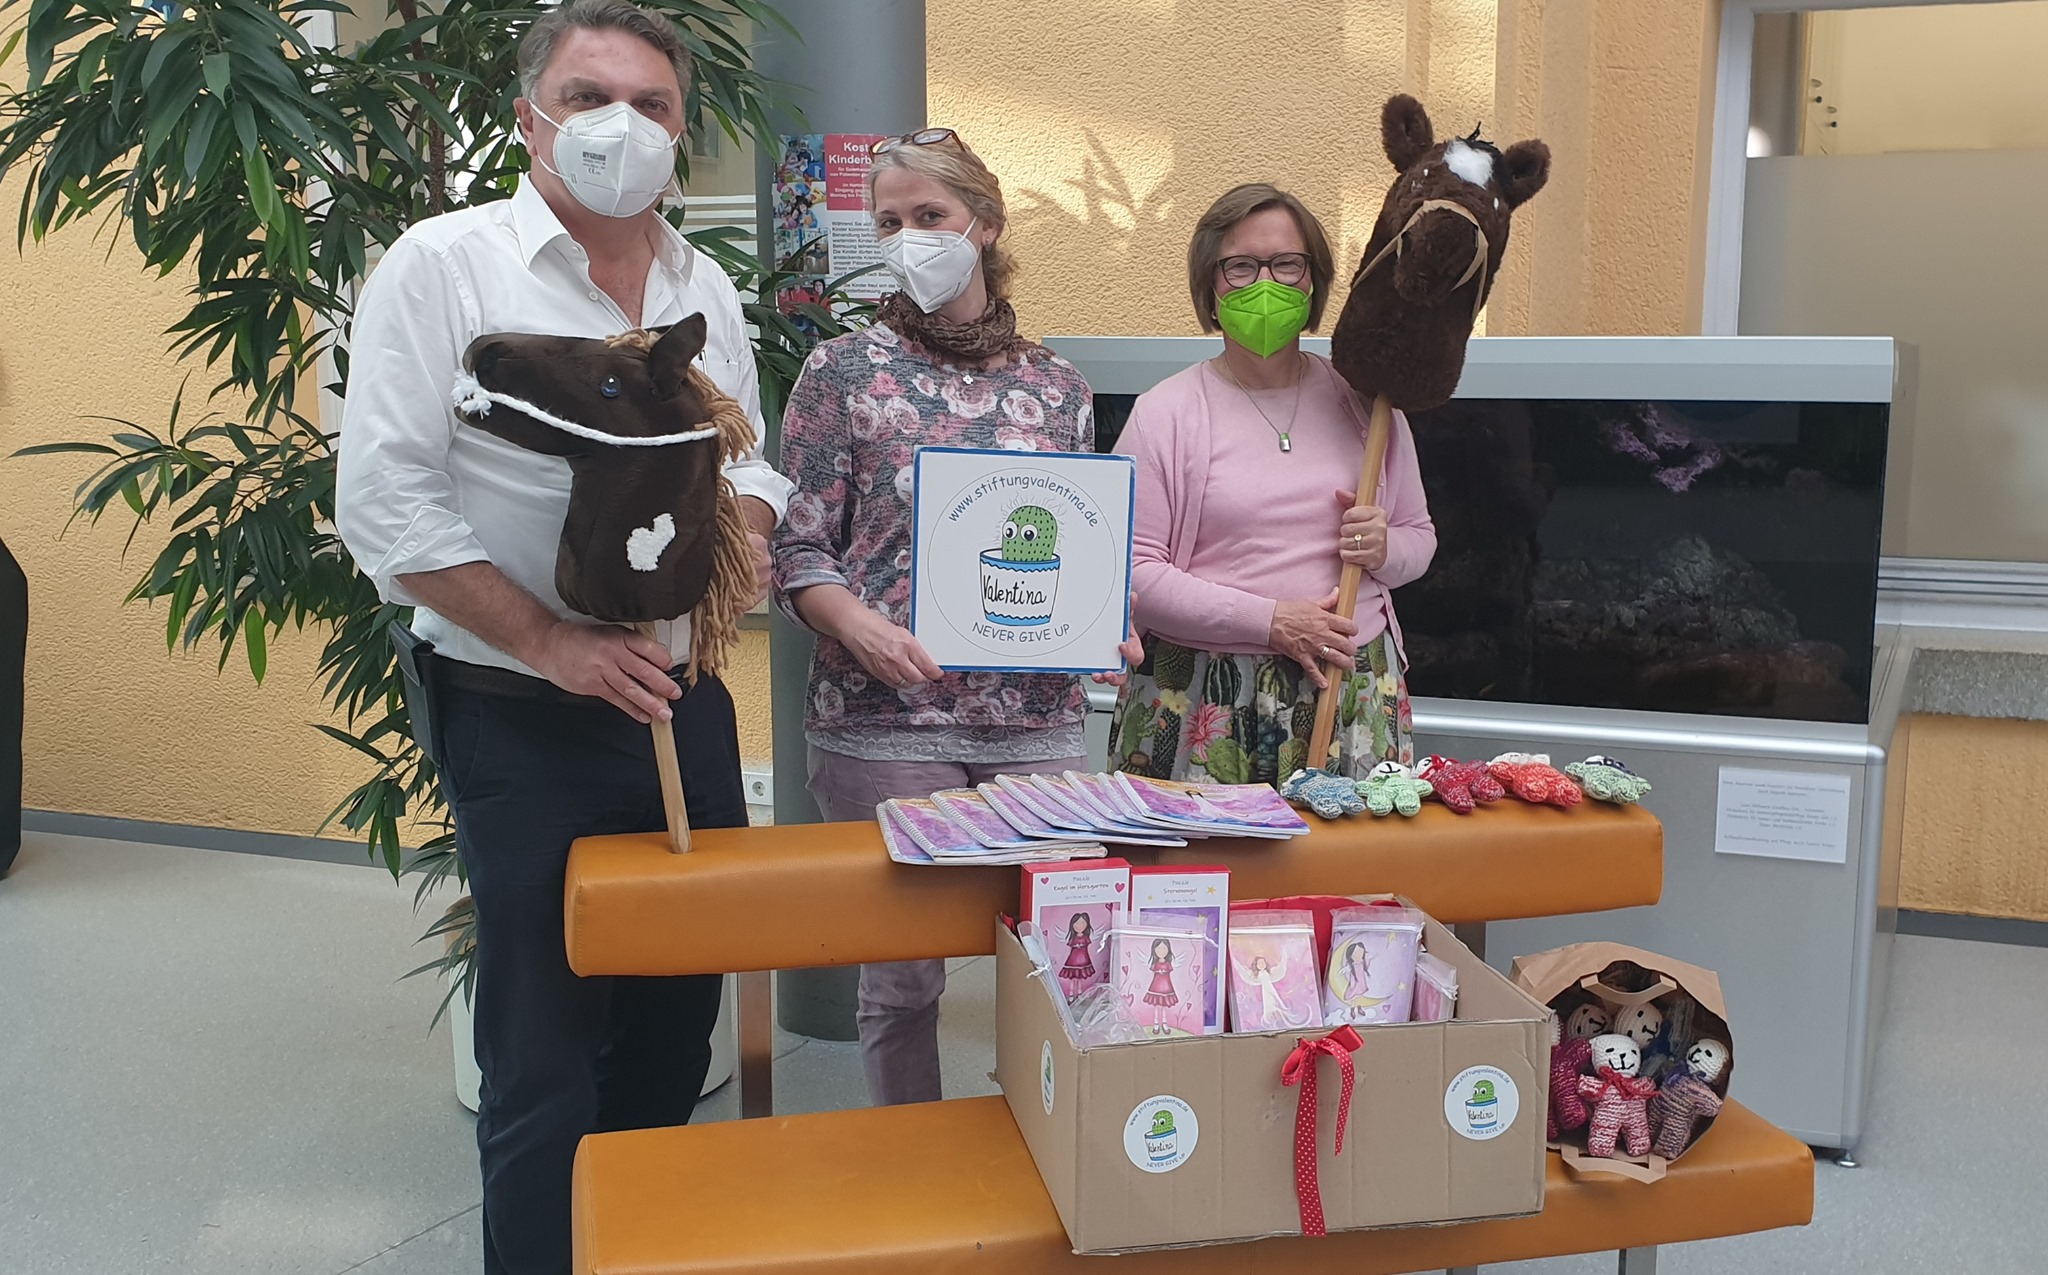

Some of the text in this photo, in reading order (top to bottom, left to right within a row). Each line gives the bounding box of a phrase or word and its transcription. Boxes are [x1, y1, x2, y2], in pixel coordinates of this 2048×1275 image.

[829, 154, 872, 164] Kinderb
[843, 142, 869, 152] Kost
[948, 475, 1099, 529] www.stiftungvalentina.de
[982, 574, 1048, 606] Valentina
[972, 621, 1071, 643] NEVER GIVE UP
[1450, 1067, 1511, 1093] www.stiftungvalentina.de
[1129, 1097, 1189, 1126] www.stiftungvalentina.de
